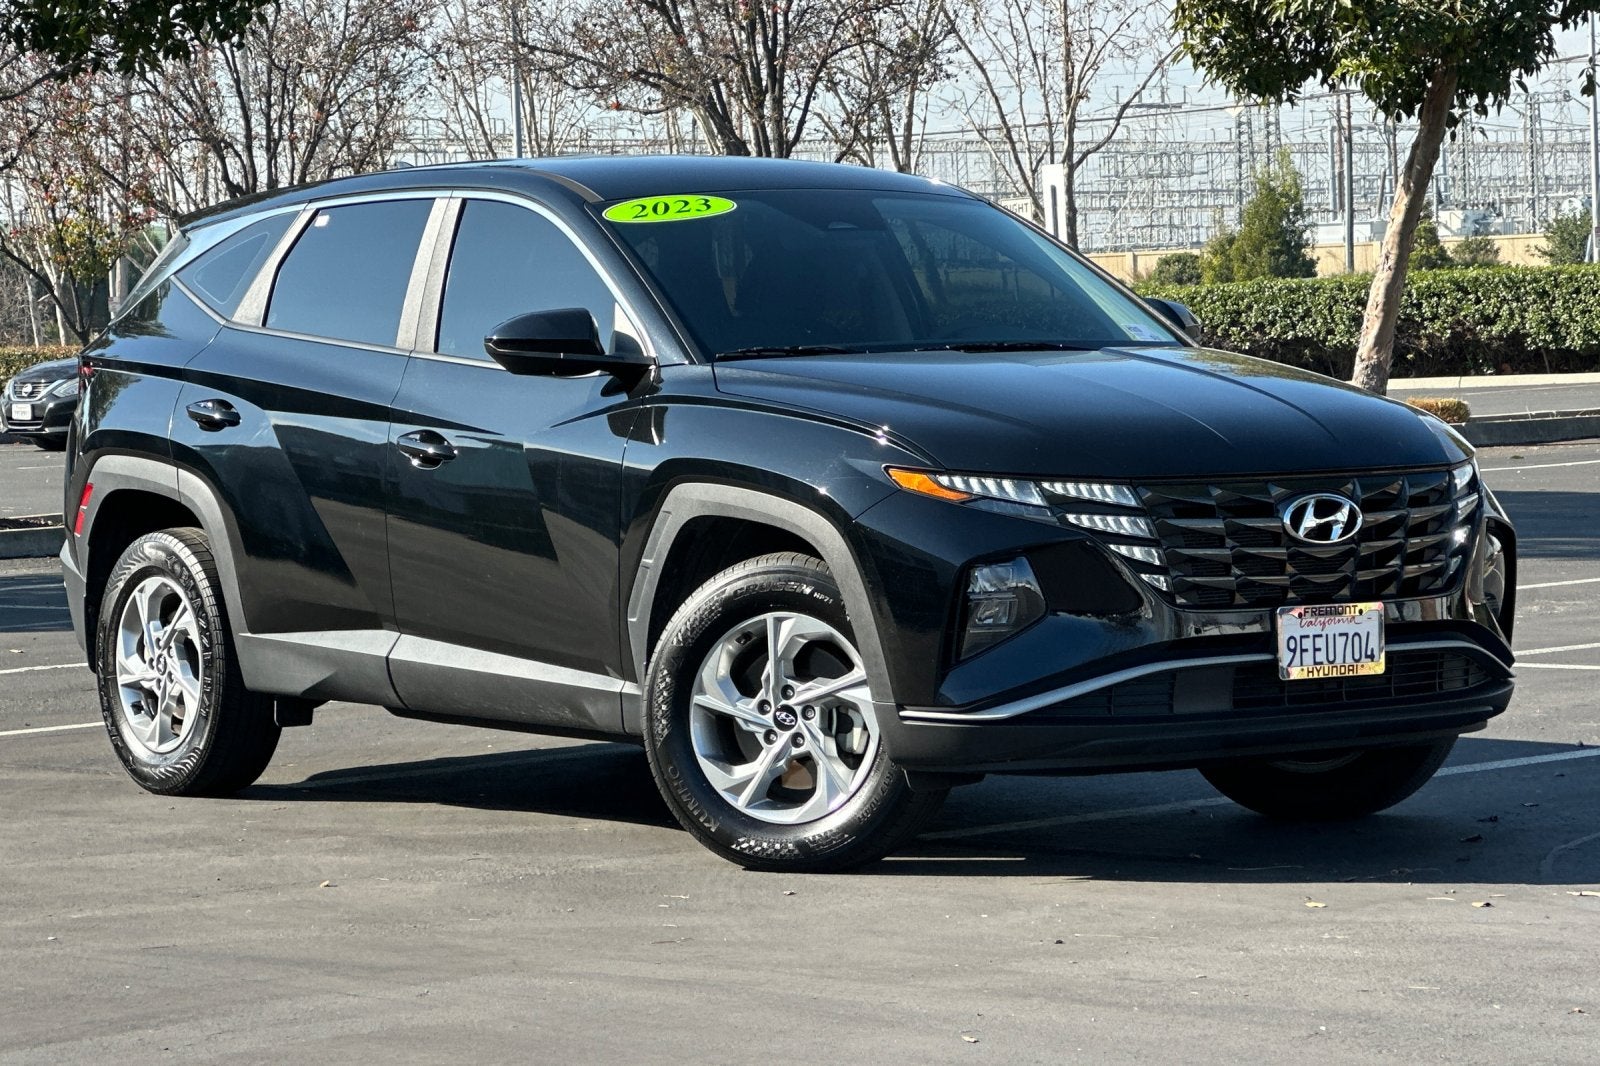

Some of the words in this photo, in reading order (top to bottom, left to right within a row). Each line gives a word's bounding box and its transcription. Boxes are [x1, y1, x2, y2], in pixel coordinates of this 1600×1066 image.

[630, 198, 712, 219] 2023
[733, 581, 815, 597] CRUGEN
[1303, 605, 1358, 617] FREMONT
[1300, 616, 1362, 631] California
[1286, 631, 1375, 667] 9FEU704
[1306, 664, 1358, 677] HYUNDAI
[668, 766, 720, 832] KUMHO
